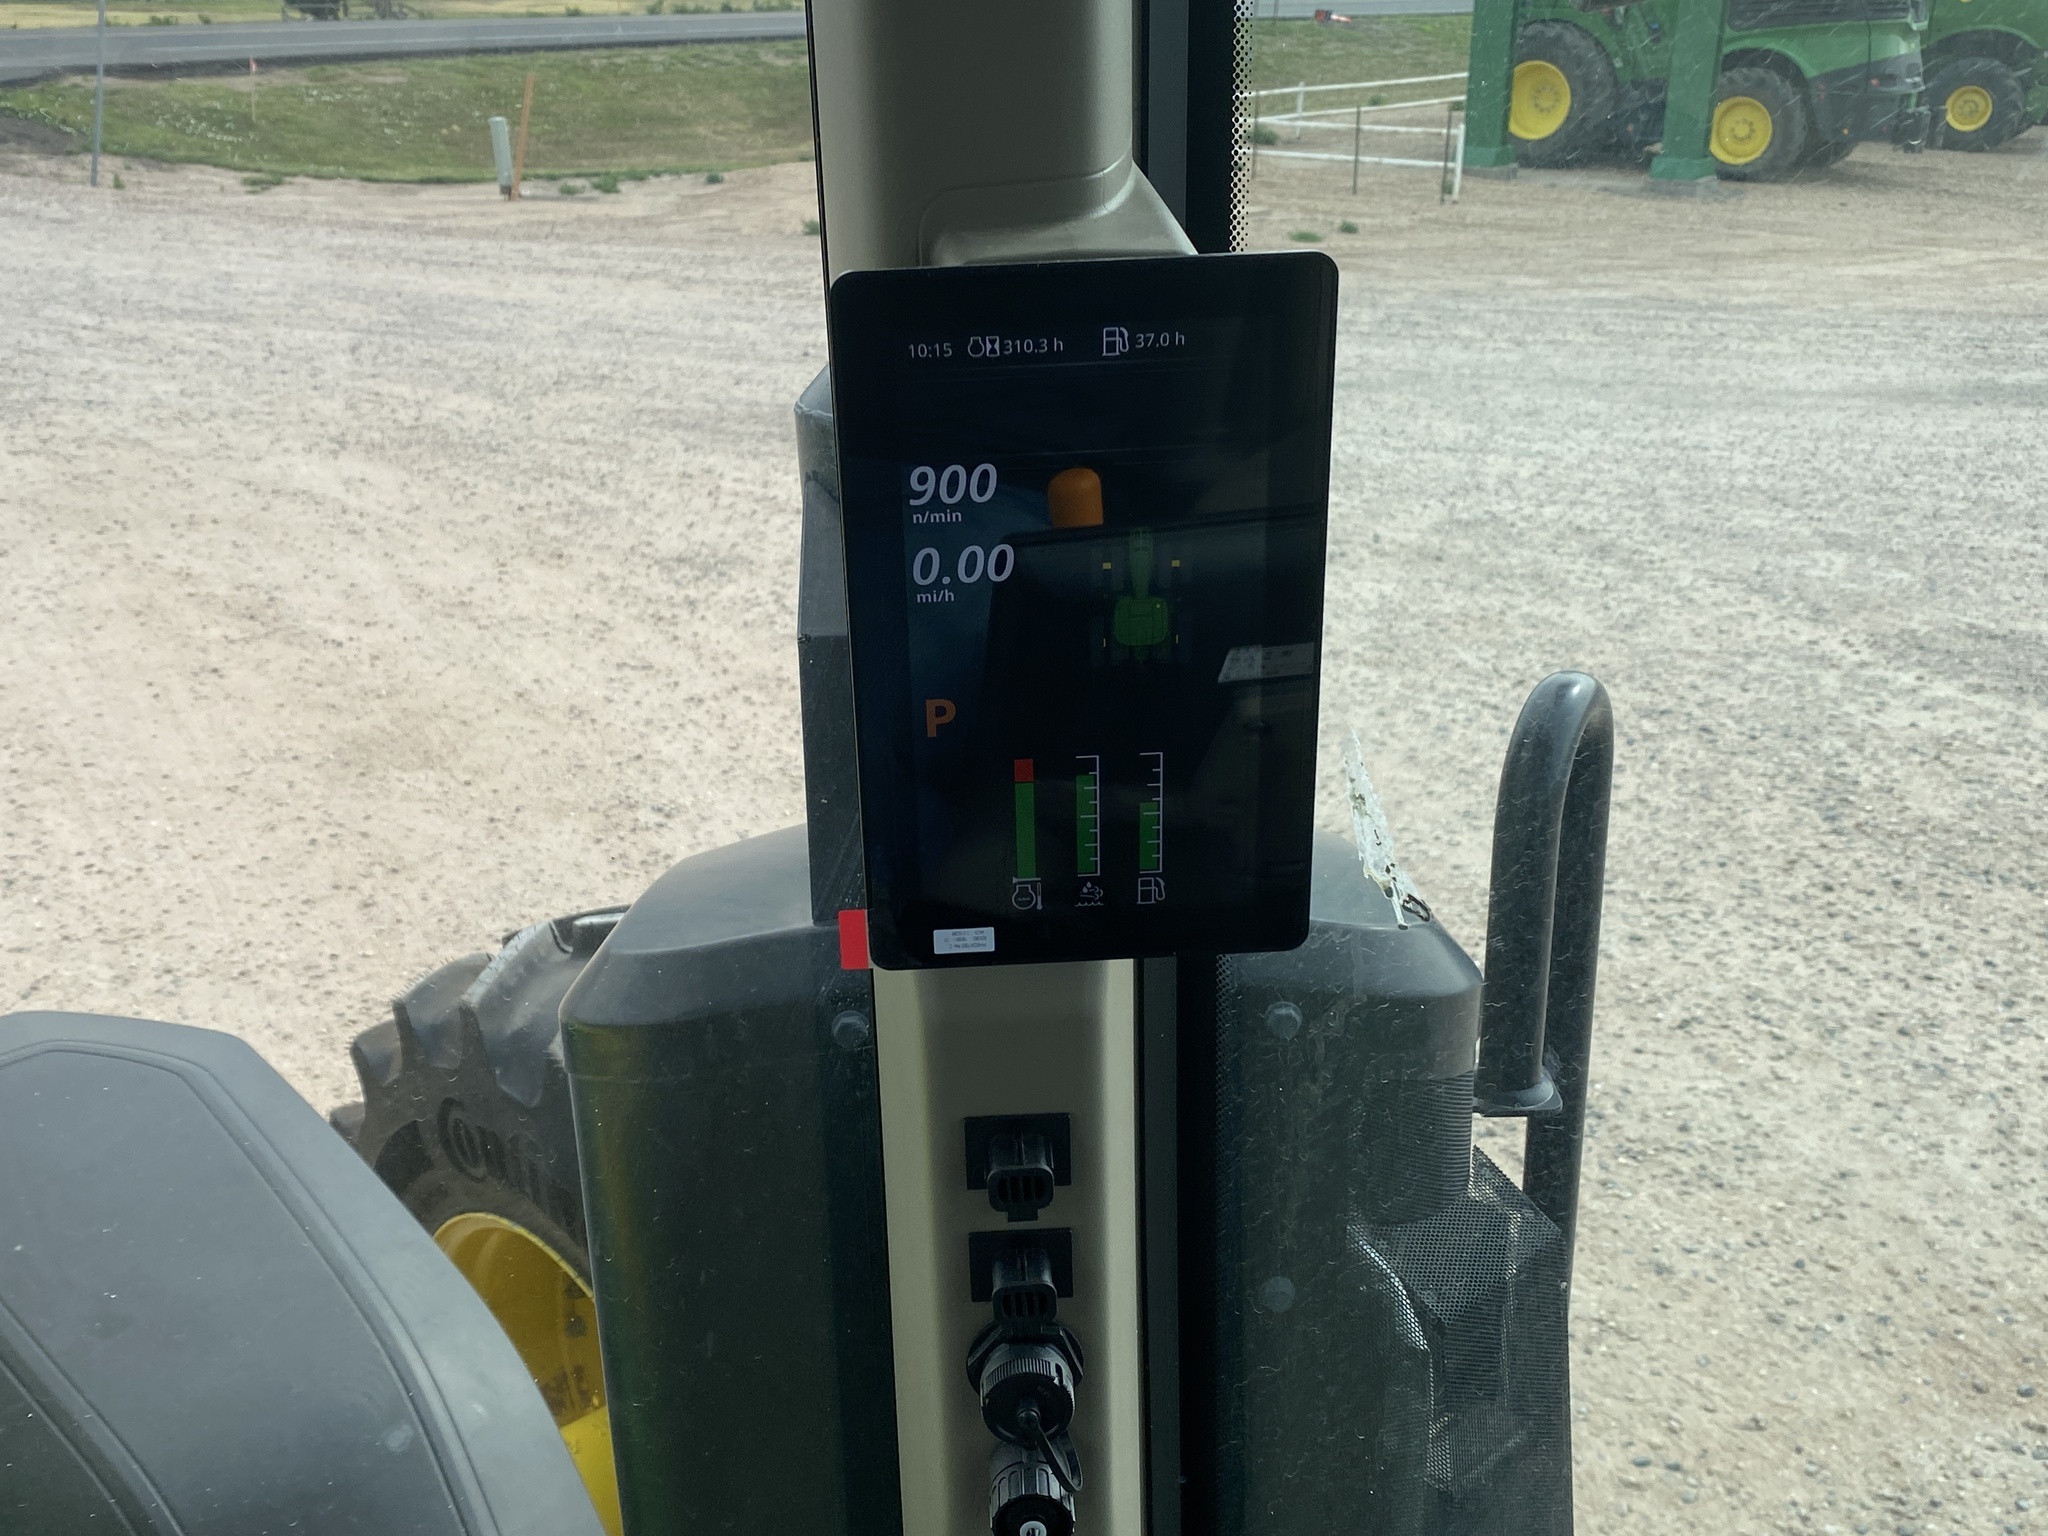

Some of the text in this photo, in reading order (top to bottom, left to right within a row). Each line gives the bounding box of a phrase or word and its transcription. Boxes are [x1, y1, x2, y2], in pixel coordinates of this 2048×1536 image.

[1003, 337, 1065, 355] 310.3 h
[1174, 331, 1186, 347] h
[908, 343, 953, 359] 10:15
[909, 462, 998, 506] 900
[912, 509, 963, 524] n/min
[912, 543, 1015, 586] 0.00
[916, 588, 955, 604] mi/h
[925, 698, 957, 738] P
